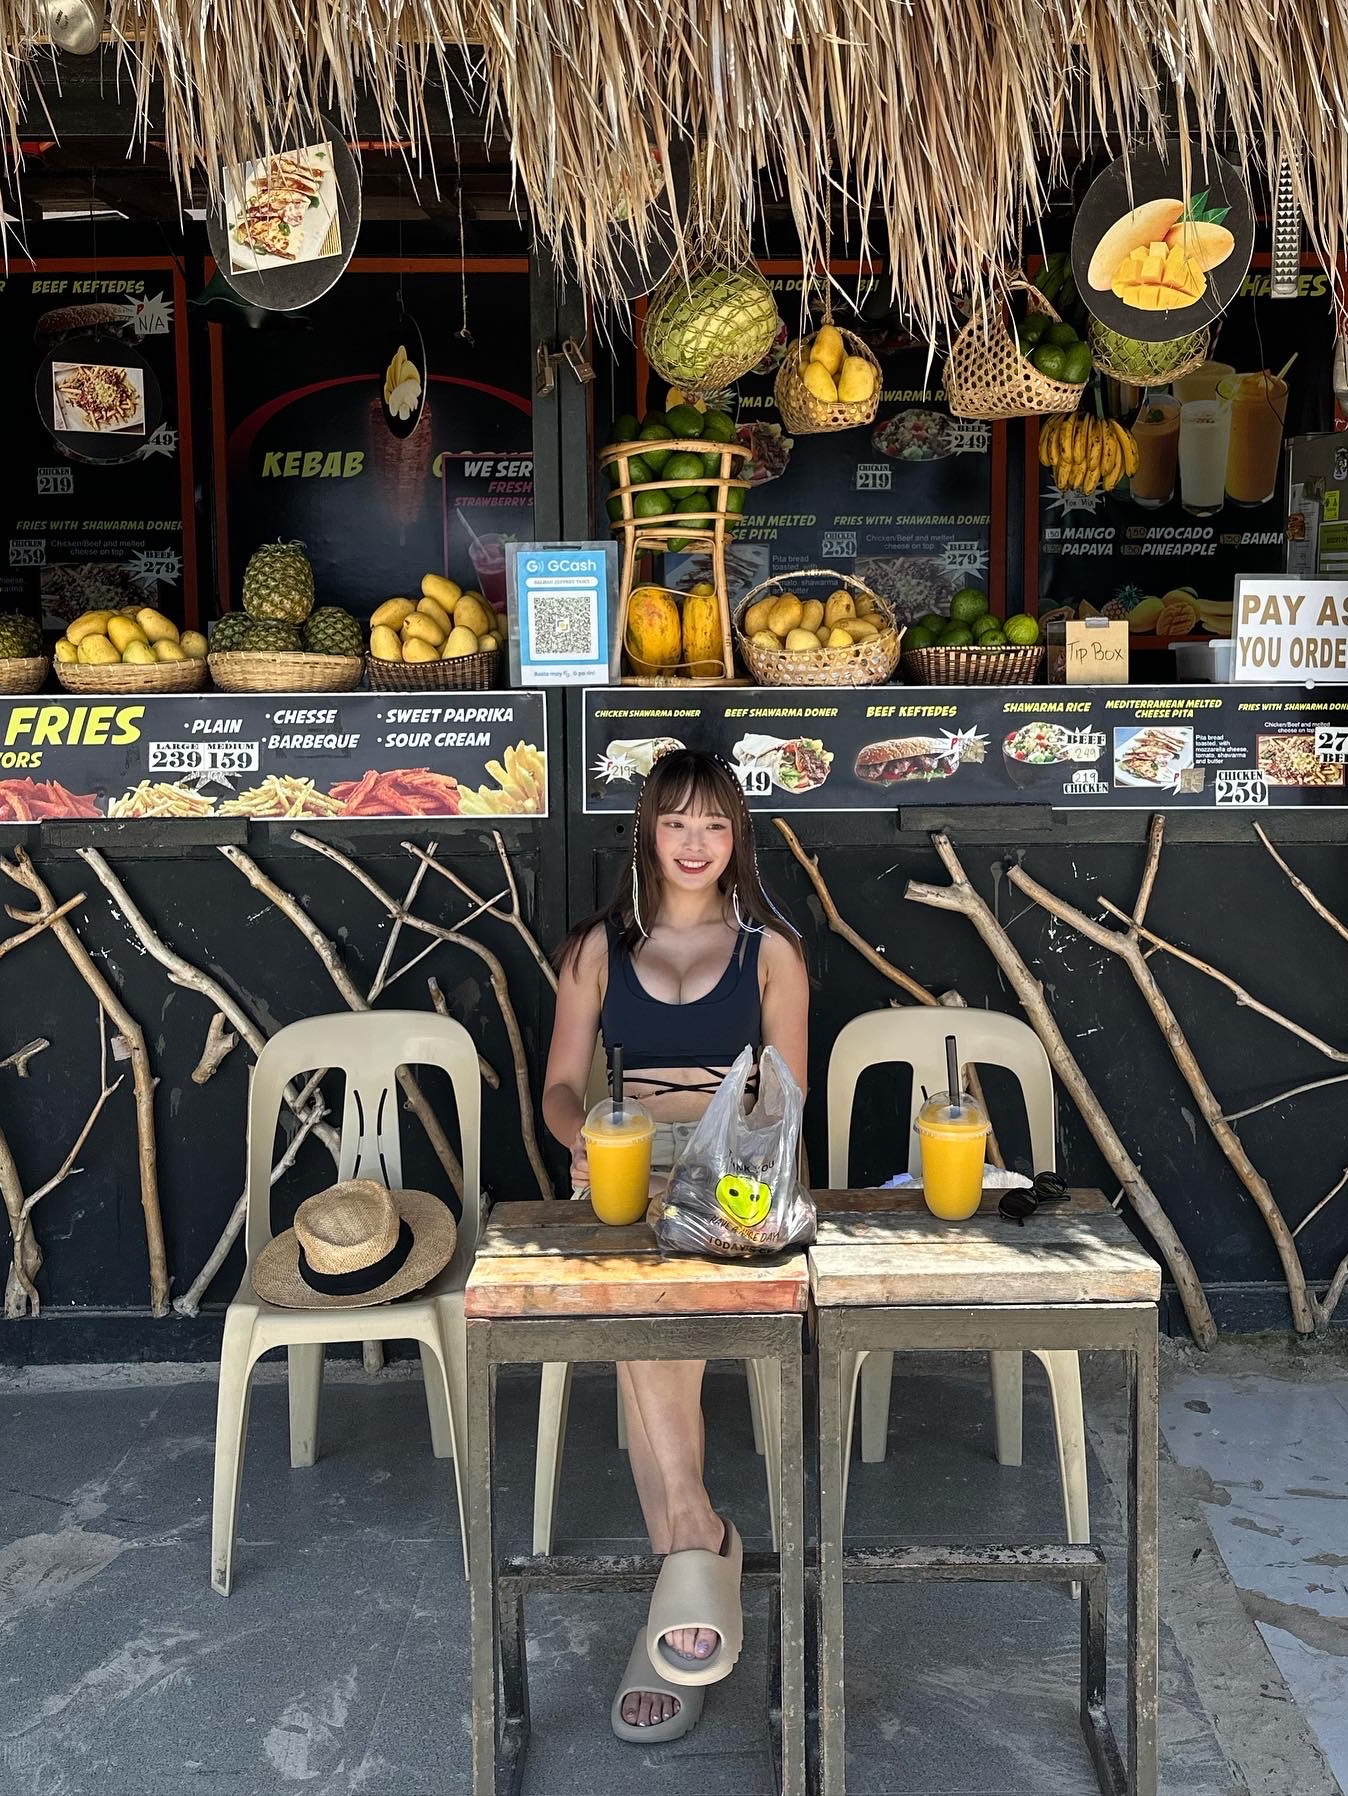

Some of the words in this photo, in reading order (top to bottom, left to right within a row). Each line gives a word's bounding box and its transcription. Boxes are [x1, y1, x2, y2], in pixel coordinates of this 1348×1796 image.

[32, 280, 69, 294] BEEF
[72, 280, 145, 294] KEFTEDES
[1240, 274, 1328, 297] HAES
[954, 434, 986, 449] 249
[262, 451, 364, 479] KEBAB
[464, 460, 494, 478] WE
[495, 460, 533, 478] SER
[40, 477, 72, 492] 219
[859, 472, 889, 488] 219
[488, 481, 533, 494] FRESH
[455, 496, 526, 506] STRAWBERRY
[16, 520, 47, 531] FRIES
[50, 520, 78, 531] WITH
[82, 520, 144, 531] SHAWARMA
[767, 514, 817, 527] MELTED
[833, 516, 863, 526] FRIES
[865, 516, 893, 525] WITH
[896, 515, 955, 525] SHAWARMA
[749, 528, 778, 540] PITA
[1062, 527, 1116, 539] MANGO
[1146, 527, 1214, 539] AVOCADO
[823, 540, 857, 556] 259
[1061, 543, 1113, 556] PAPAYA
[1141, 543, 1217, 556] PINEAPPLE
[11, 549, 45, 565] 259
[948, 553, 978, 566] 279
[143, 561, 176, 574] 279
[547, 559, 597, 572] GCash
[1241, 595, 1305, 626] PAY
[1239, 637, 1282, 668] YOU
[1290, 637, 1347, 668] ORDE
[1003, 702, 1065, 713] SHAWARMA
[1065, 702, 1092, 712] RICE
[1105, 700, 1185, 709] MEDITERRANEAN
[1185, 699, 1222, 708] MELTED
[1238, 703, 1260, 711] FRIES
[1262, 703, 1282, 711] WITH
[1283, 703, 1328, 711] SHAWARMA
[273, 709, 338, 725] CHESSE
[385, 709, 442, 723] SWEET
[443, 708, 513, 722] PAPRIKA
[594, 710, 629, 718] CHICKEN
[674, 709, 701, 717] DONER
[724, 708, 749, 718] BEEF
[749, 708, 803, 717] SHAWARMA
[804, 708, 839, 717] DONER
[866, 706, 896, 717] BEEF
[898, 705, 957, 717] KEFTEDES
[1135, 709, 1170, 718] CHEESE
[1171, 709, 1194, 718] PITA
[4, 706, 146, 746] FRIES
[192, 718, 243, 734] PLAIN
[268, 734, 360, 750] BARBEQUE
[385, 733, 432, 748] SOUR
[434, 732, 491, 747] CREAM
[1067, 735, 1106, 745] BEEF
[1318, 732, 1348, 751] 27
[152, 750, 202, 768] 239
[208, 751, 253, 769] 159
[1075, 748, 1097, 759] 249
[0, 752, 43, 769] ORS
[612, 765, 632, 776] 219
[1218, 771, 1263, 781] CHICKEN
[1075, 772, 1097, 783] 219
[1064, 783, 1109, 794] CHICKEN
[1217, 781, 1267, 803] 259
[709, 1215, 730, 1230] HAVE
